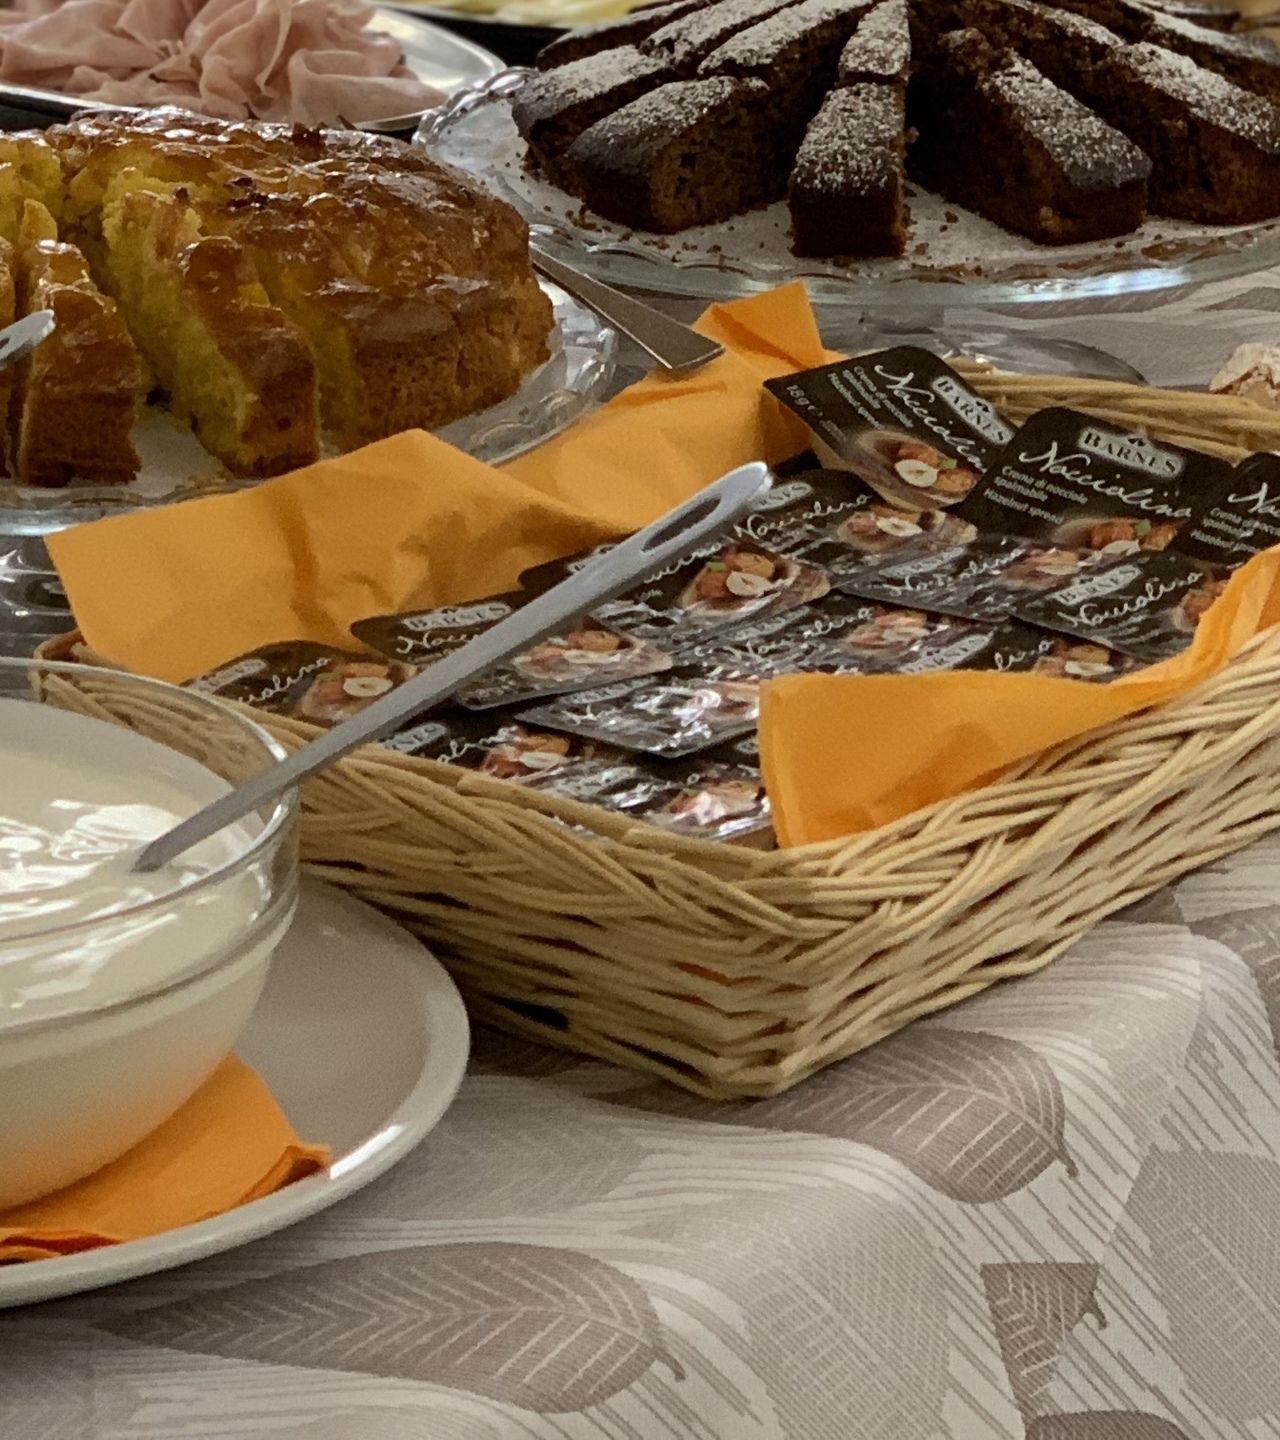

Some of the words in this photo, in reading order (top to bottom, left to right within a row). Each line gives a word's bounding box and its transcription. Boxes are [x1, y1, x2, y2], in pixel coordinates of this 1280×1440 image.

[874, 364, 989, 474] Nocciolin
[936, 379, 1006, 443] BARNES
[1083, 431, 1176, 474] BARNES
[993, 475, 1050, 502] spalmabile
[1001, 465, 1035, 487] Crema
[1046, 481, 1089, 505] nocciole
[1019, 440, 1192, 518] Nocciolina
[983, 487, 1030, 512] Hazelnut
[1028, 504, 1065, 526] spread
[1210, 507, 1242, 525] Crema
[1056, 571, 1204, 628] Nocciolina
